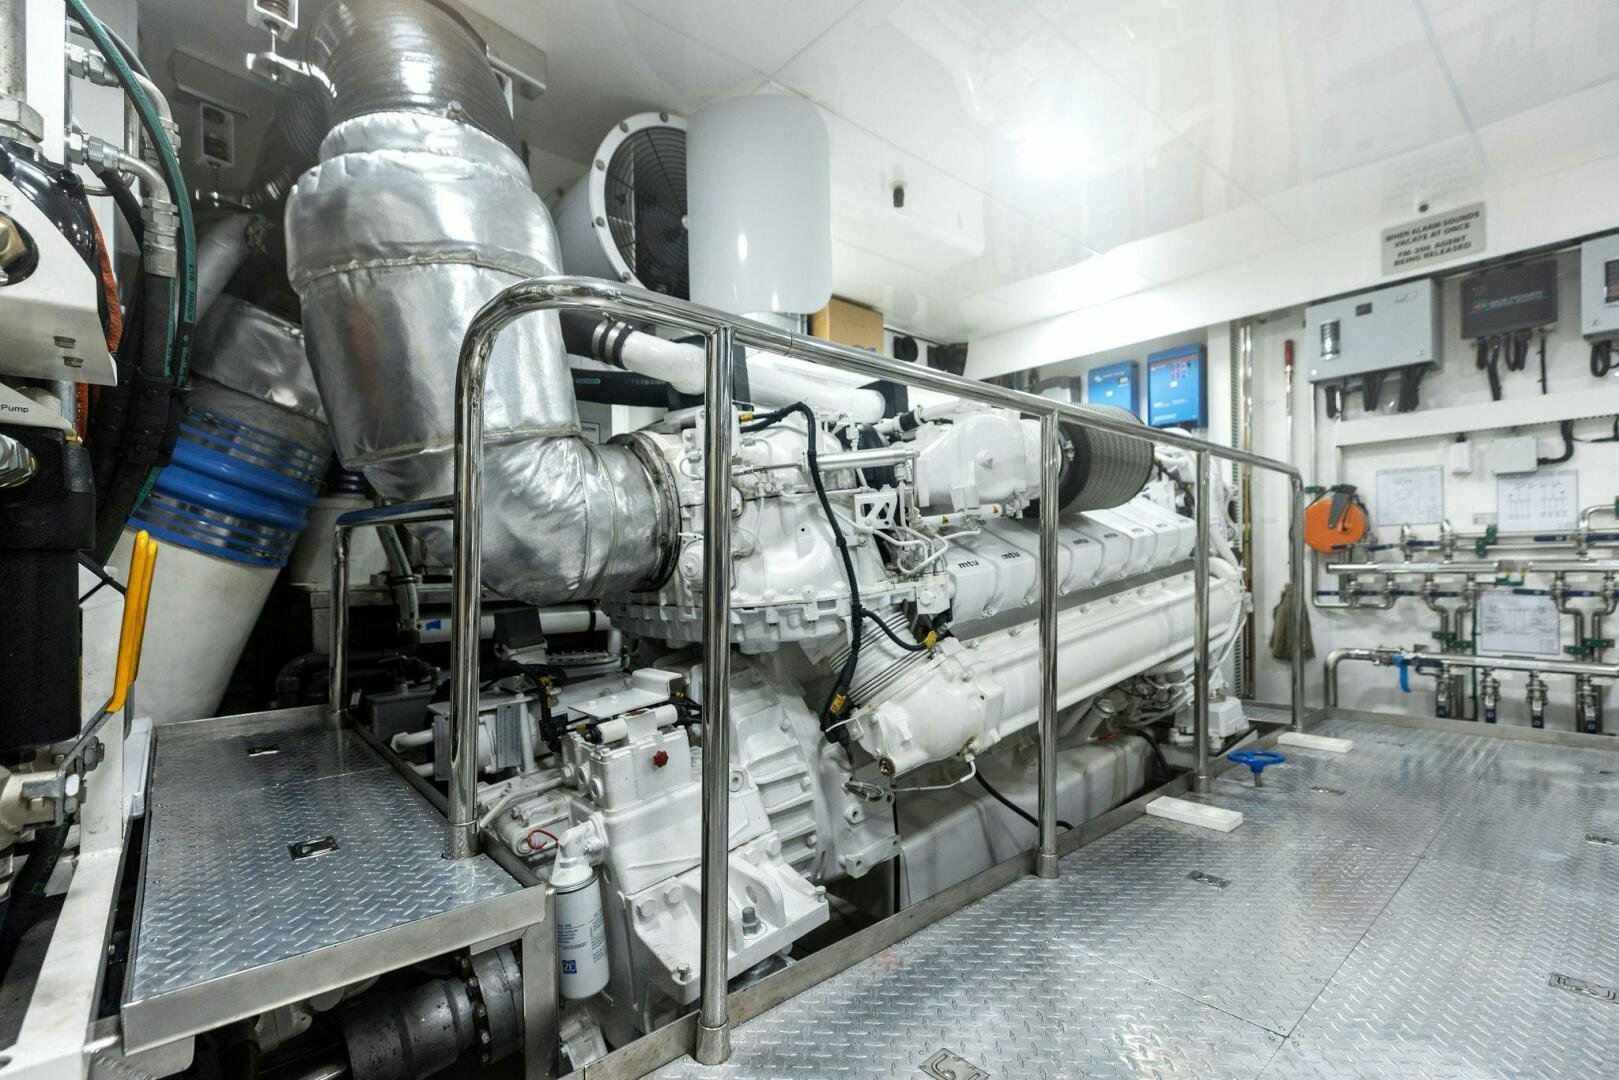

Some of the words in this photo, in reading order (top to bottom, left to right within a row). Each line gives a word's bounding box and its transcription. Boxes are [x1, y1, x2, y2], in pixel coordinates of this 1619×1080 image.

[1385, 231, 1410, 242] WHEN
[1412, 221, 1441, 234] ALARM
[1443, 210, 1480, 226] SOUNDS
[1394, 234, 1428, 247] VACATE
[1430, 229, 1441, 238] AT
[1443, 222, 1470, 234] ONCE
[1434, 234, 1466, 248] AGENT
[1393, 255, 1421, 267] BEING
[1423, 241, 1472, 259] RELEASED
[0, 403, 30, 414] Pump
[958, 560, 980, 568] mtu
